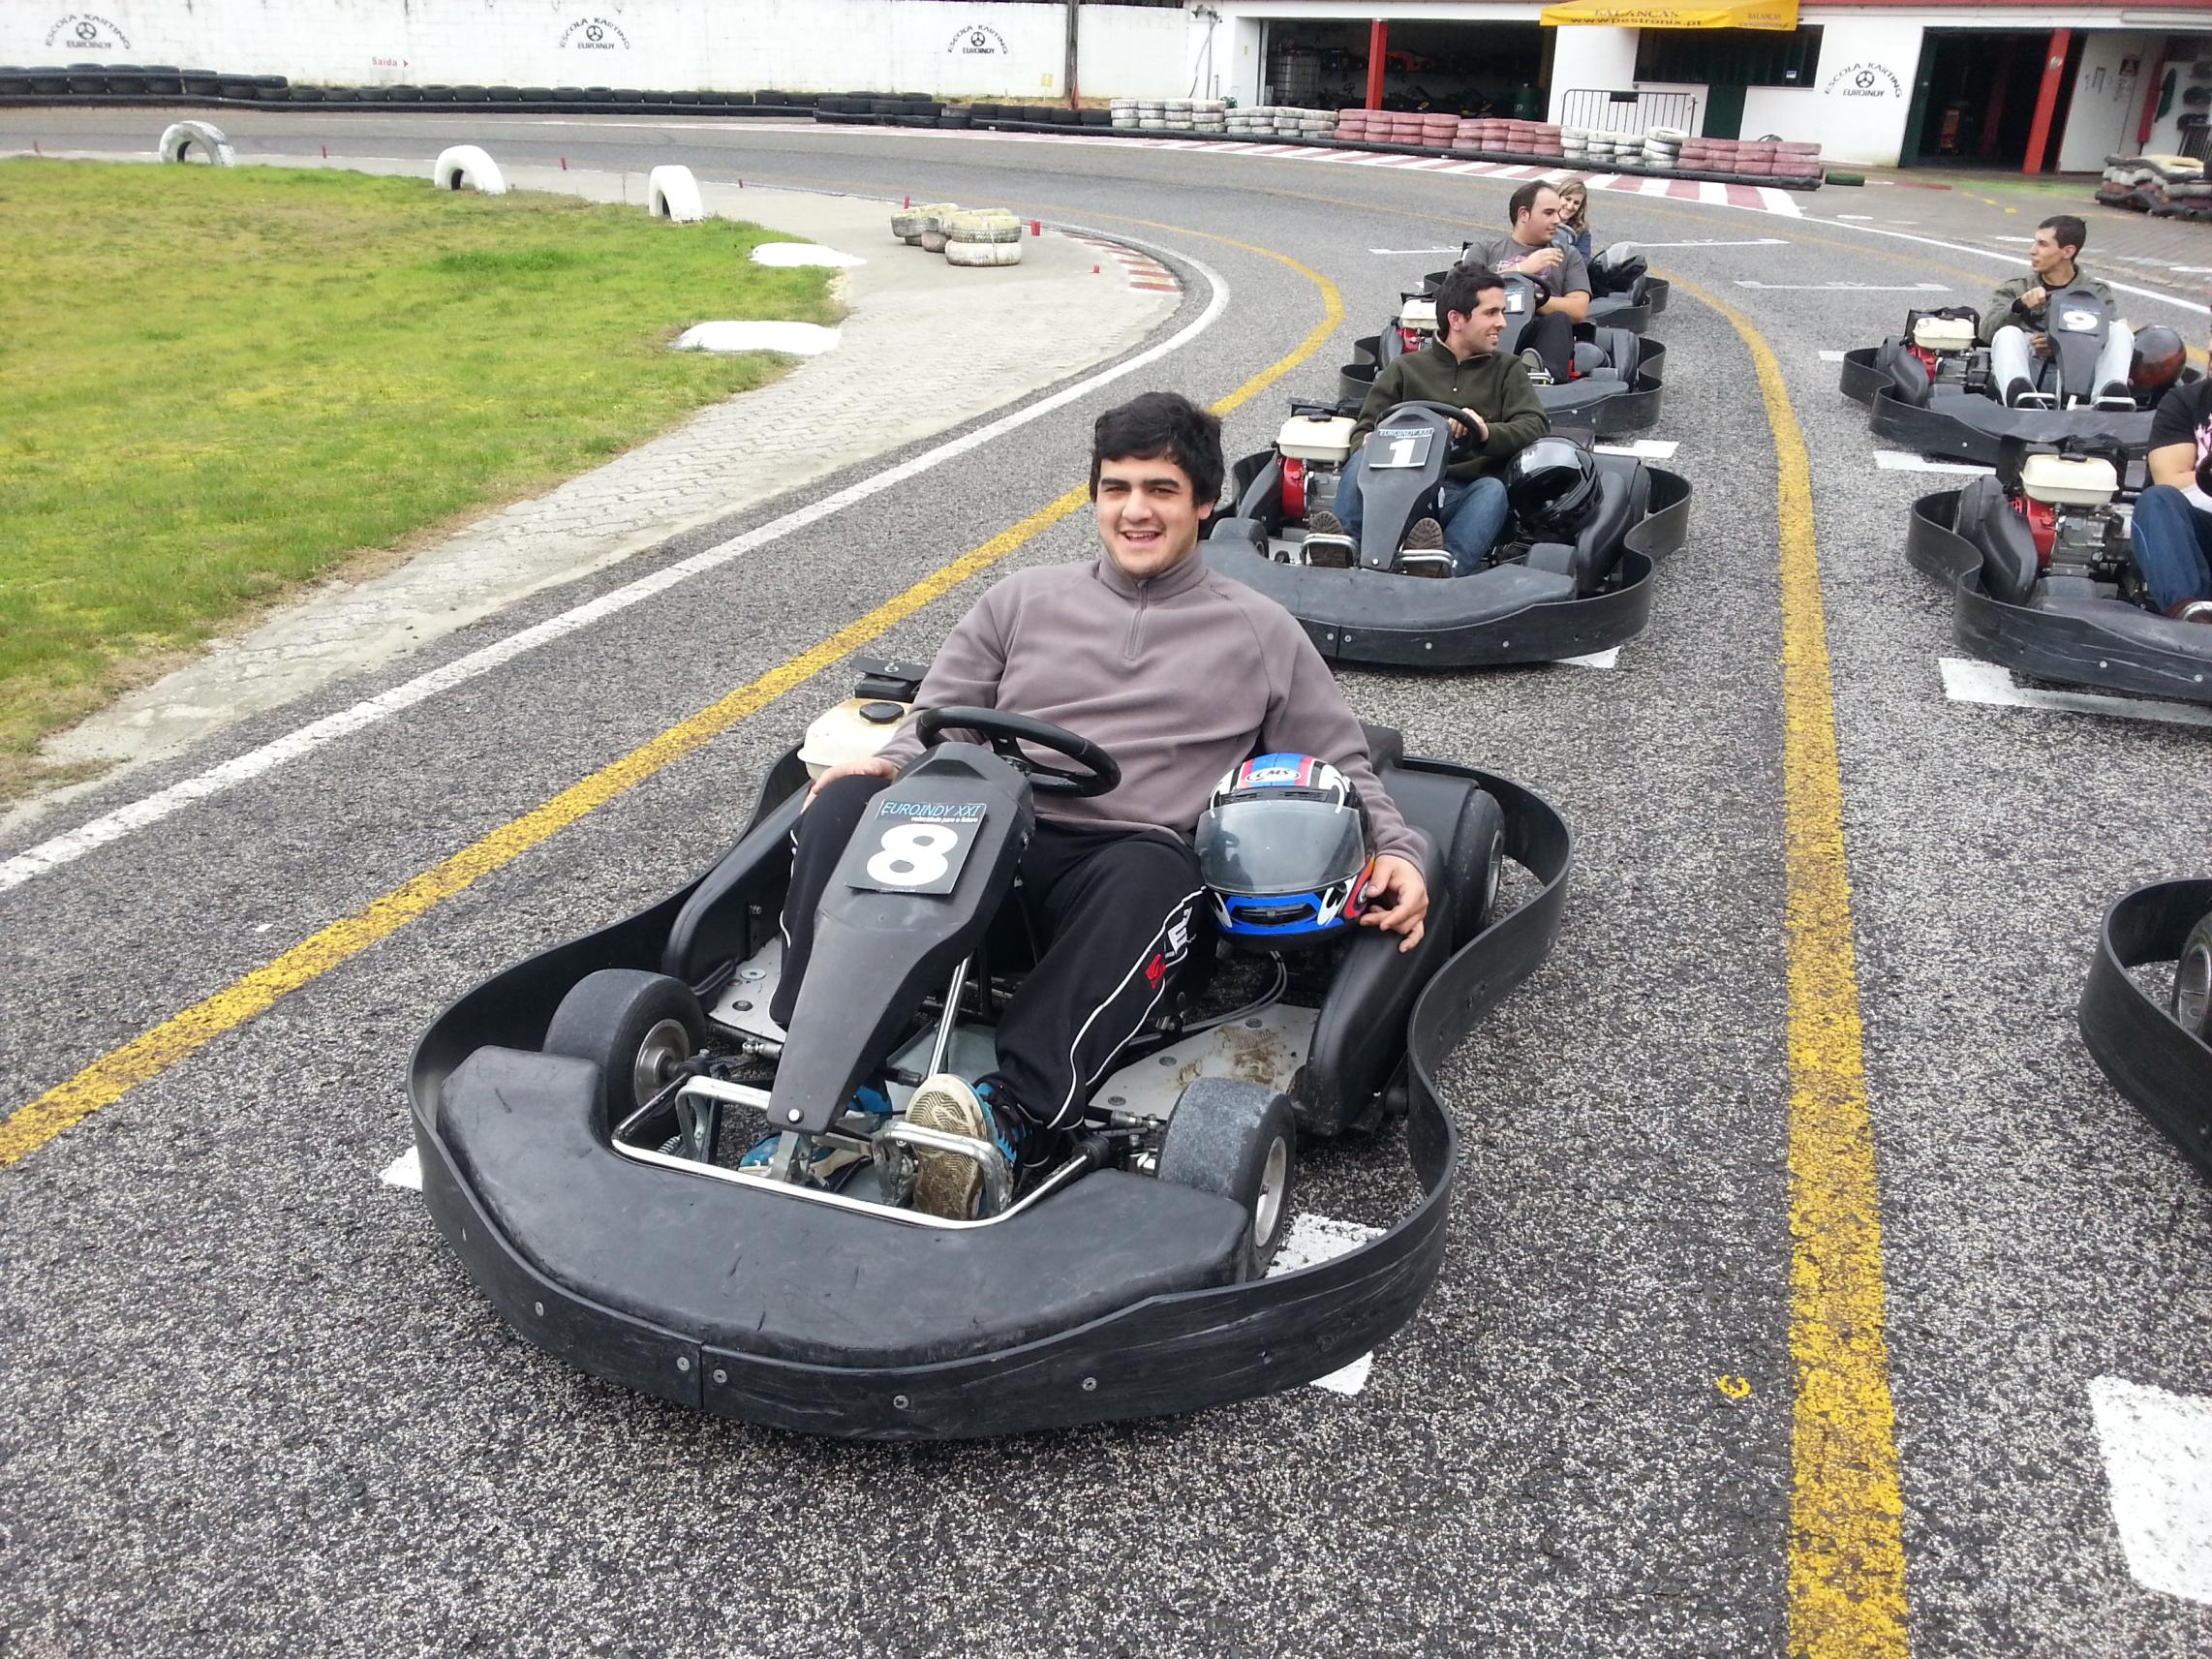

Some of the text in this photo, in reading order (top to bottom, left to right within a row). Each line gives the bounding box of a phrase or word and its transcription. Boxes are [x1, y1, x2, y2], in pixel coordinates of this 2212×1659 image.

[46, 14, 131, 49] ESCOLA KARTING
[560, 17, 630, 49] ESCOLA KARTING
[948, 24, 1008, 54] ESCOLA KARTING
[1825, 62, 1902, 98] ESCOLA KARTING
[1843, 88, 1885, 97] EUROINDY
[2063, 311, 2098, 330] 9
[1390, 439, 1416, 465] 1
[881, 802, 981, 816] EUROINDY XXI
[867, 823, 958, 886] 8
